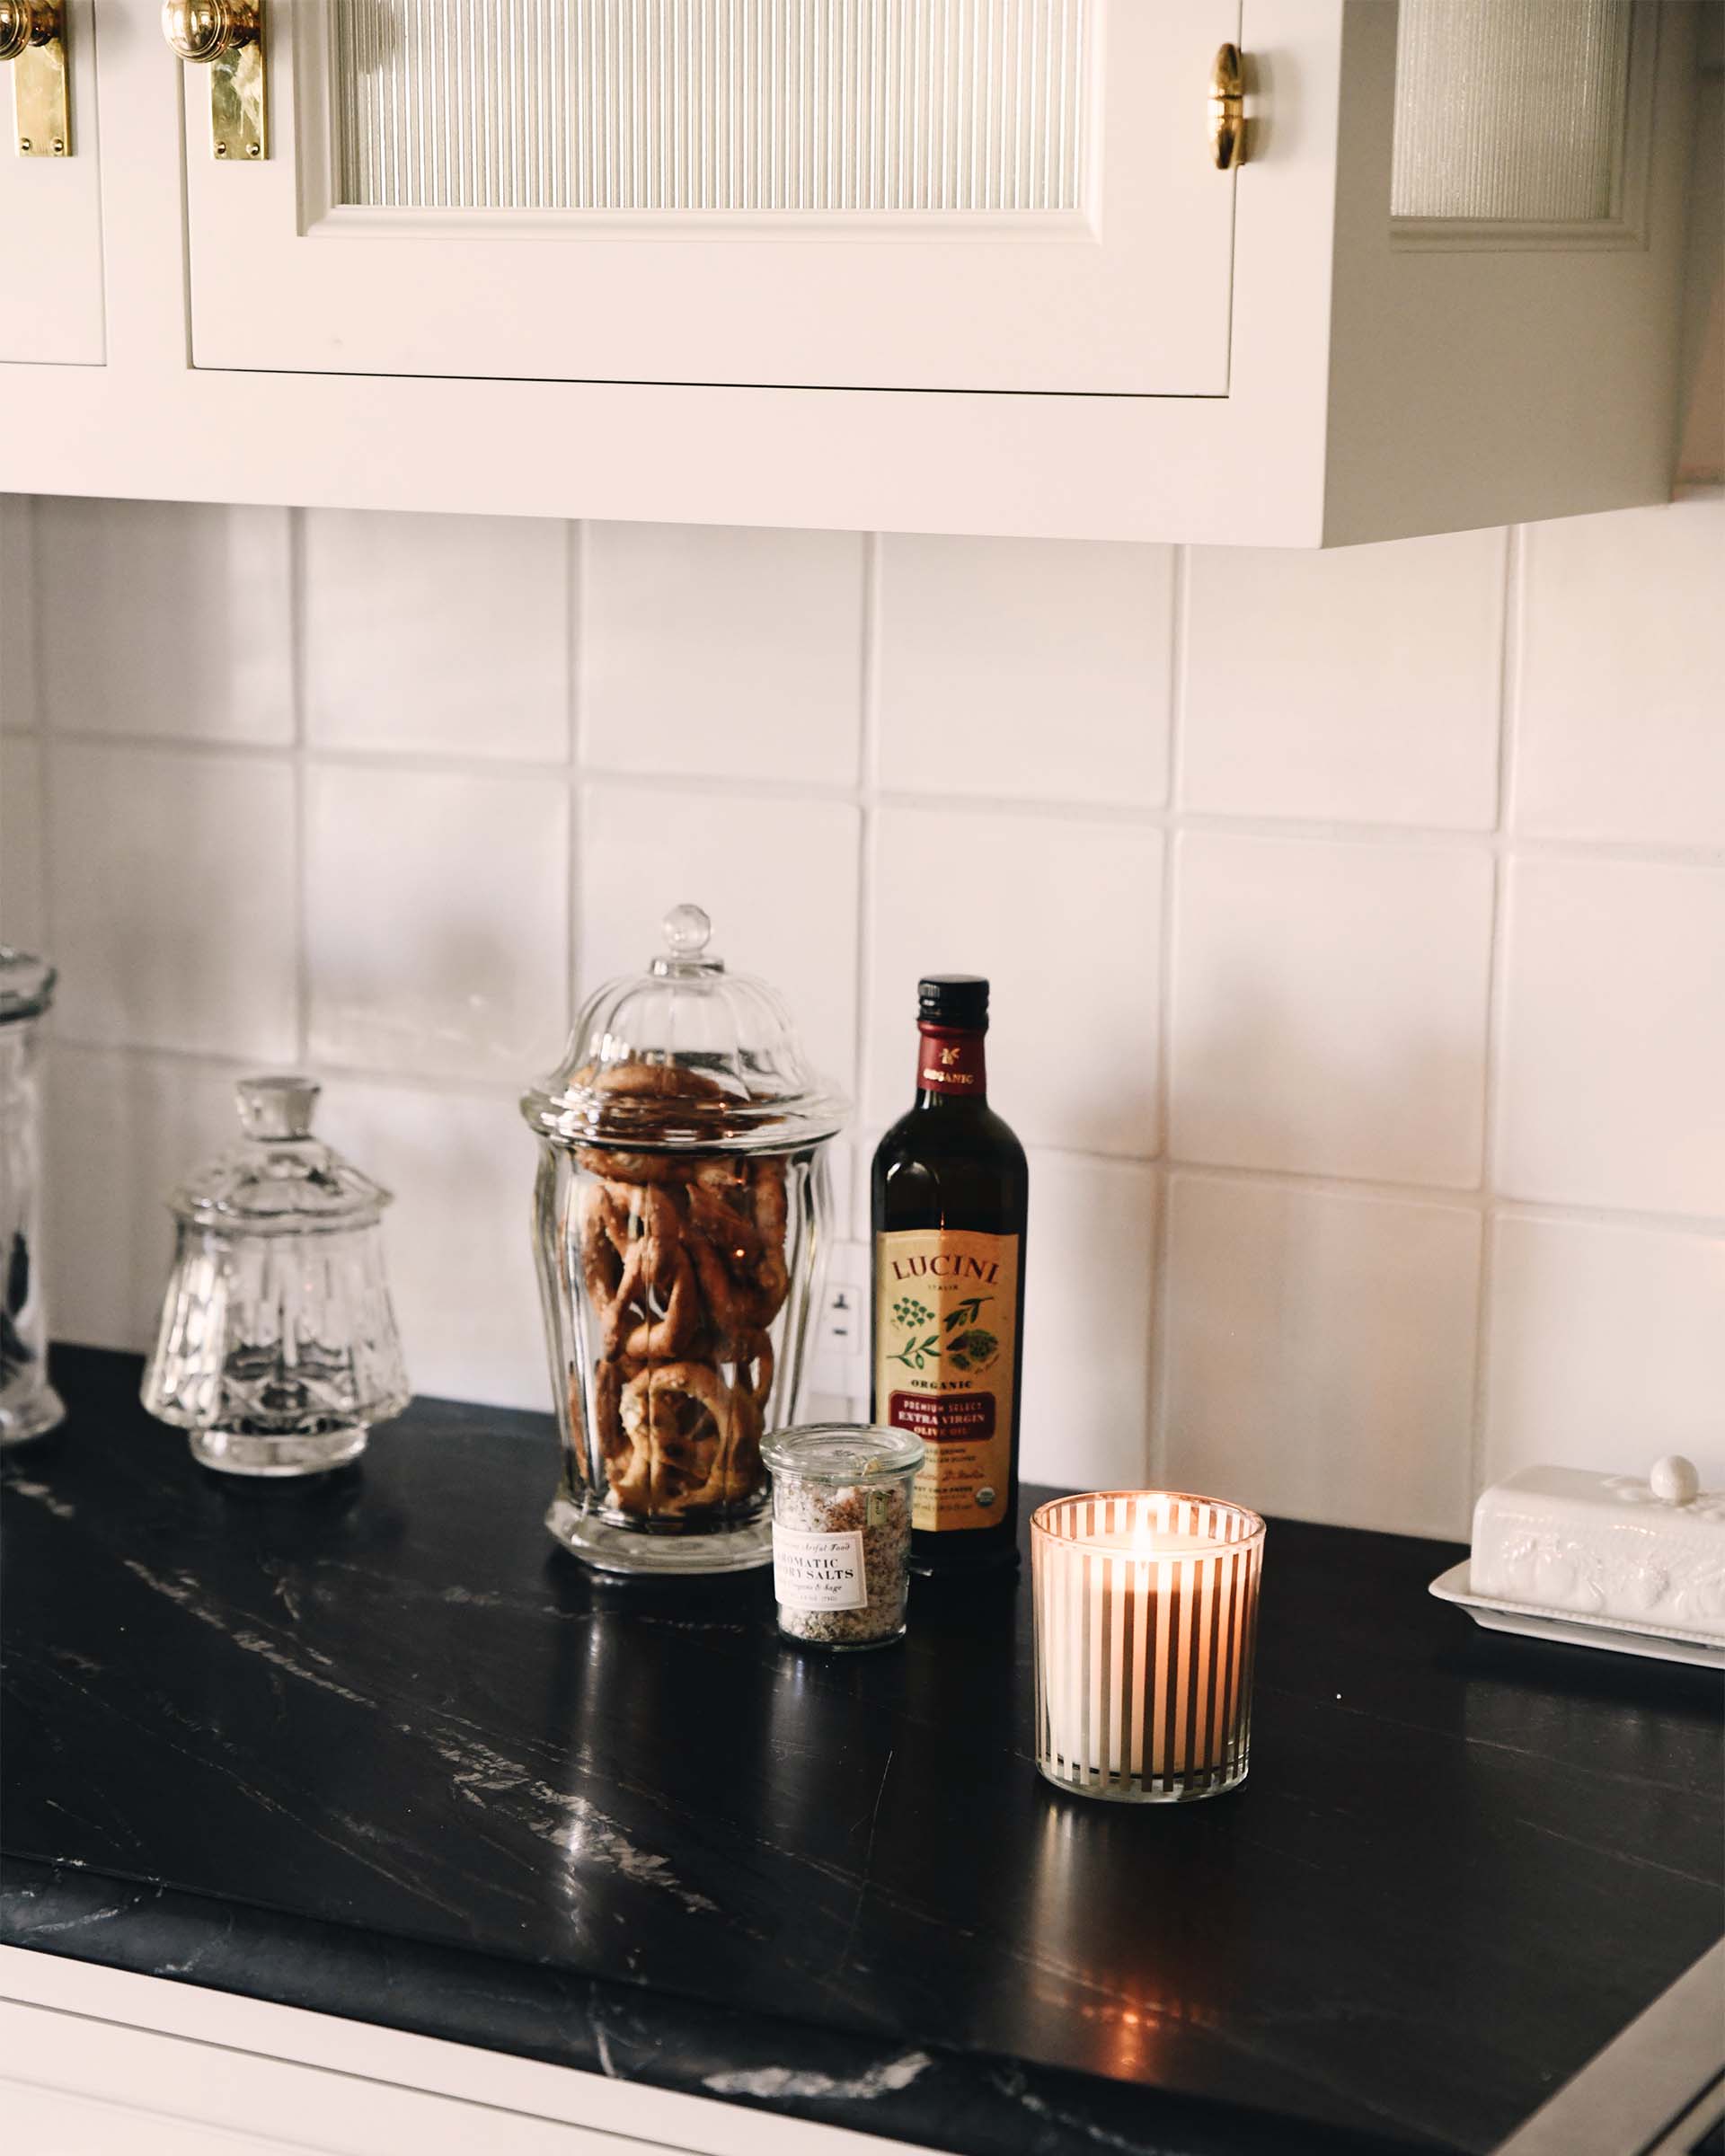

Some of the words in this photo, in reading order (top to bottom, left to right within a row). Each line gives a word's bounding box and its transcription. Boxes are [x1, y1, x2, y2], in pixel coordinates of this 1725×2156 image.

[891, 1255, 1000, 1285] LUCINI
[911, 1379, 973, 1390] ORGANIC
[904, 1401, 943, 1412] PREMIUM
[898, 1411, 938, 1425] EXTRA
[942, 1413, 986, 1425] VIRGIN
[806, 1569, 854, 1580] SALTS
